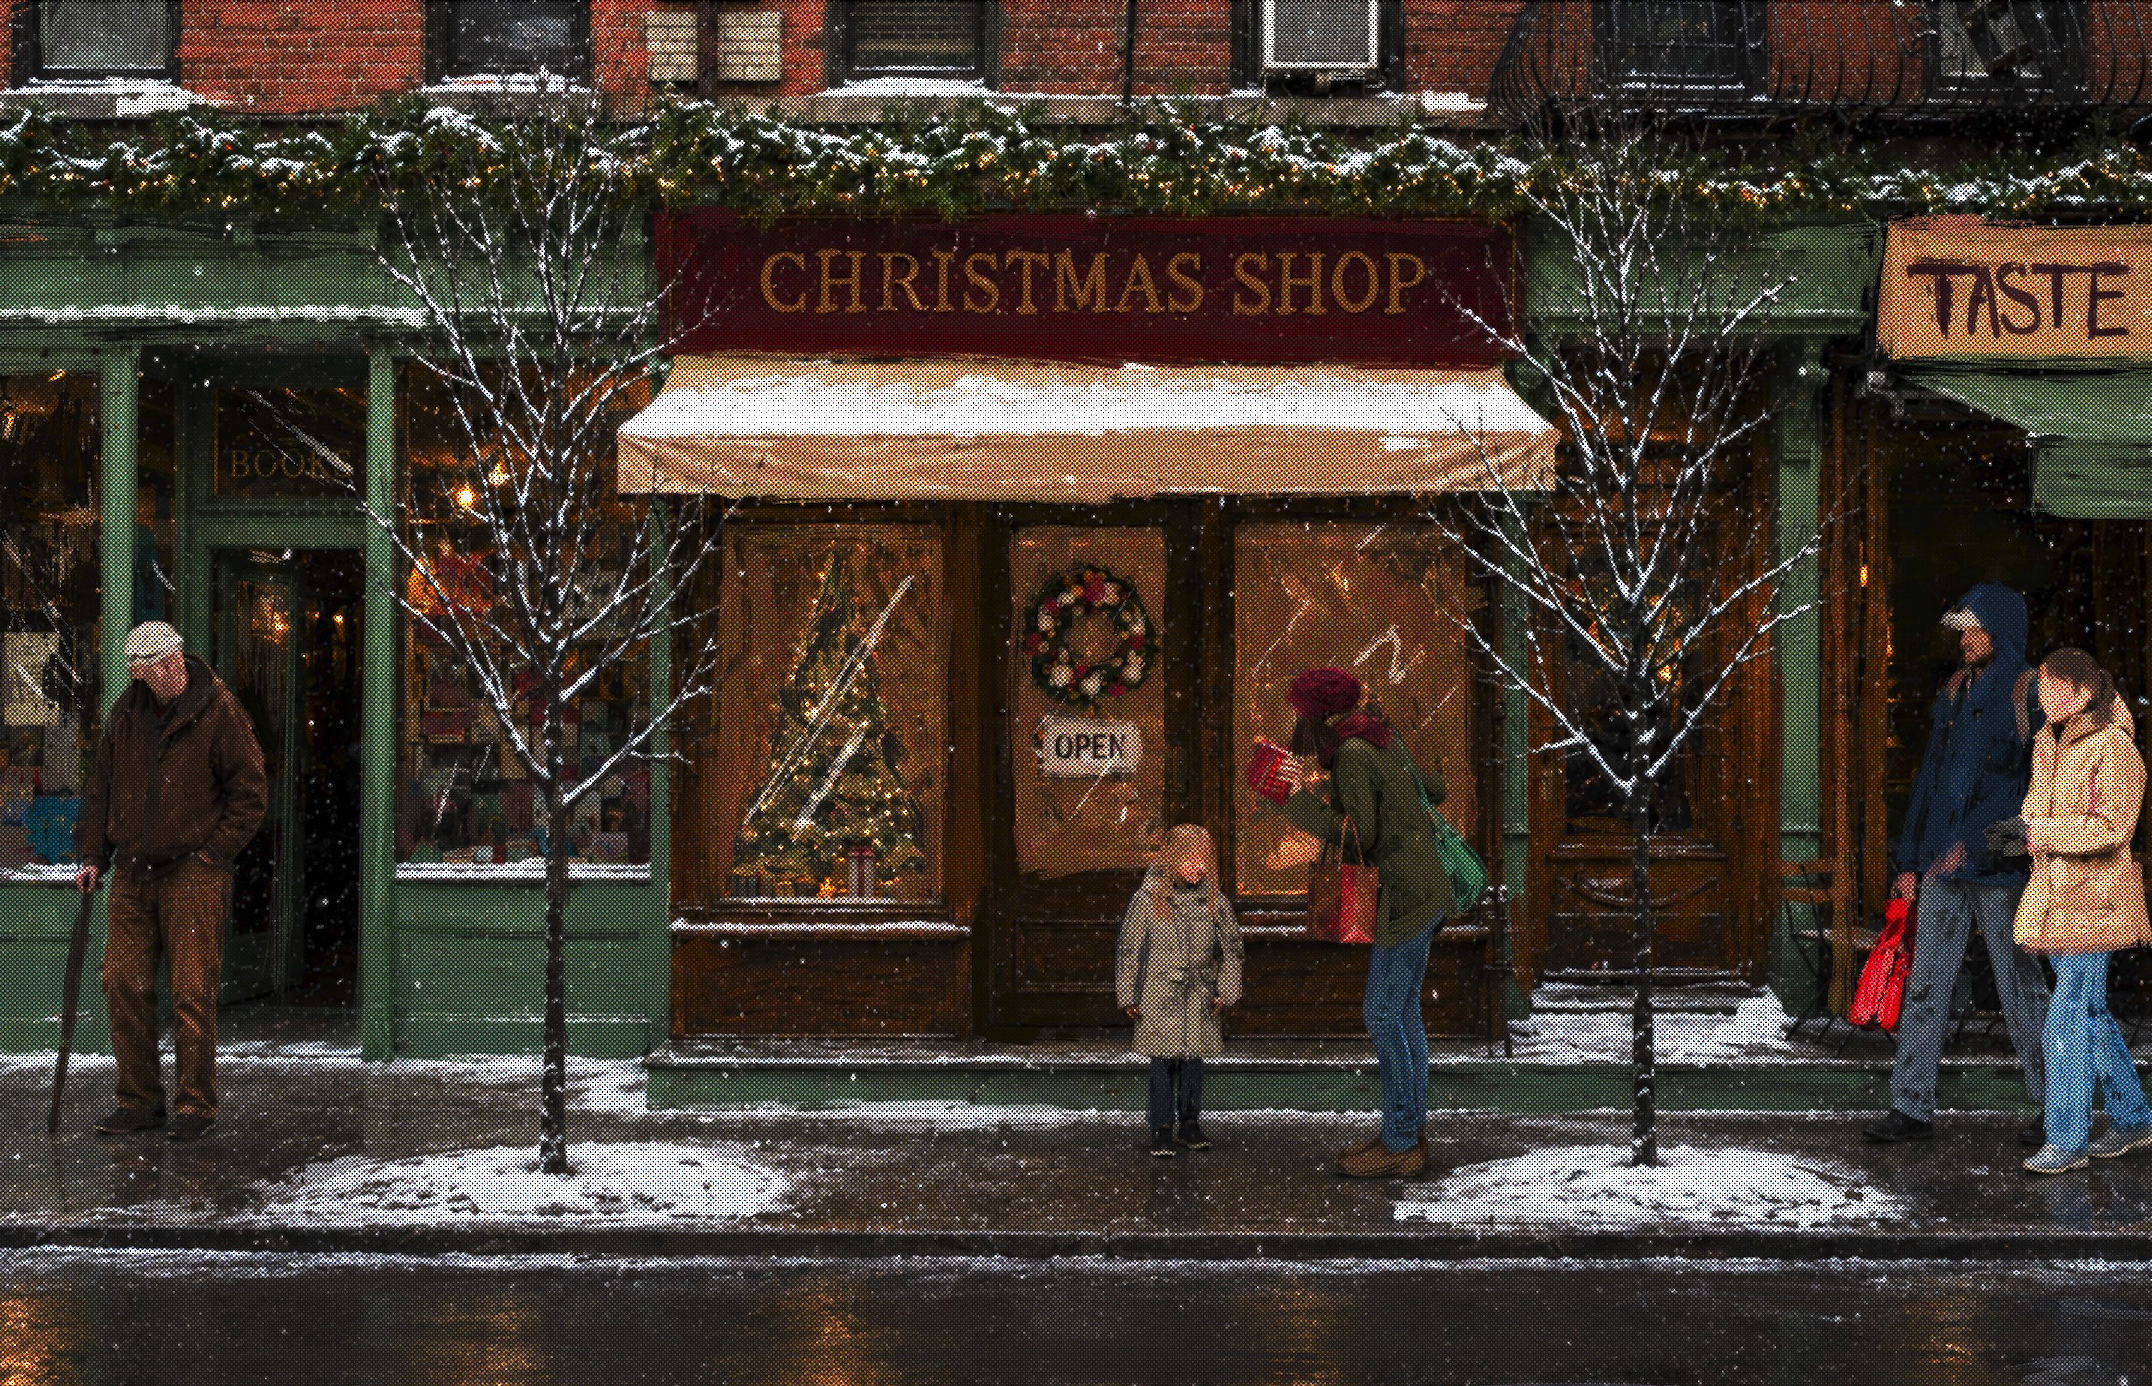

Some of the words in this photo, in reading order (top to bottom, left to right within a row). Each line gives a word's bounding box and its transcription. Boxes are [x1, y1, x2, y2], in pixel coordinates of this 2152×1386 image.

[760, 249, 1203, 314] CHRISTMAS
[1233, 251, 1426, 315] SHOP
[1906, 260, 2130, 339] TASTE
[1055, 733, 1125, 759] OPEN
